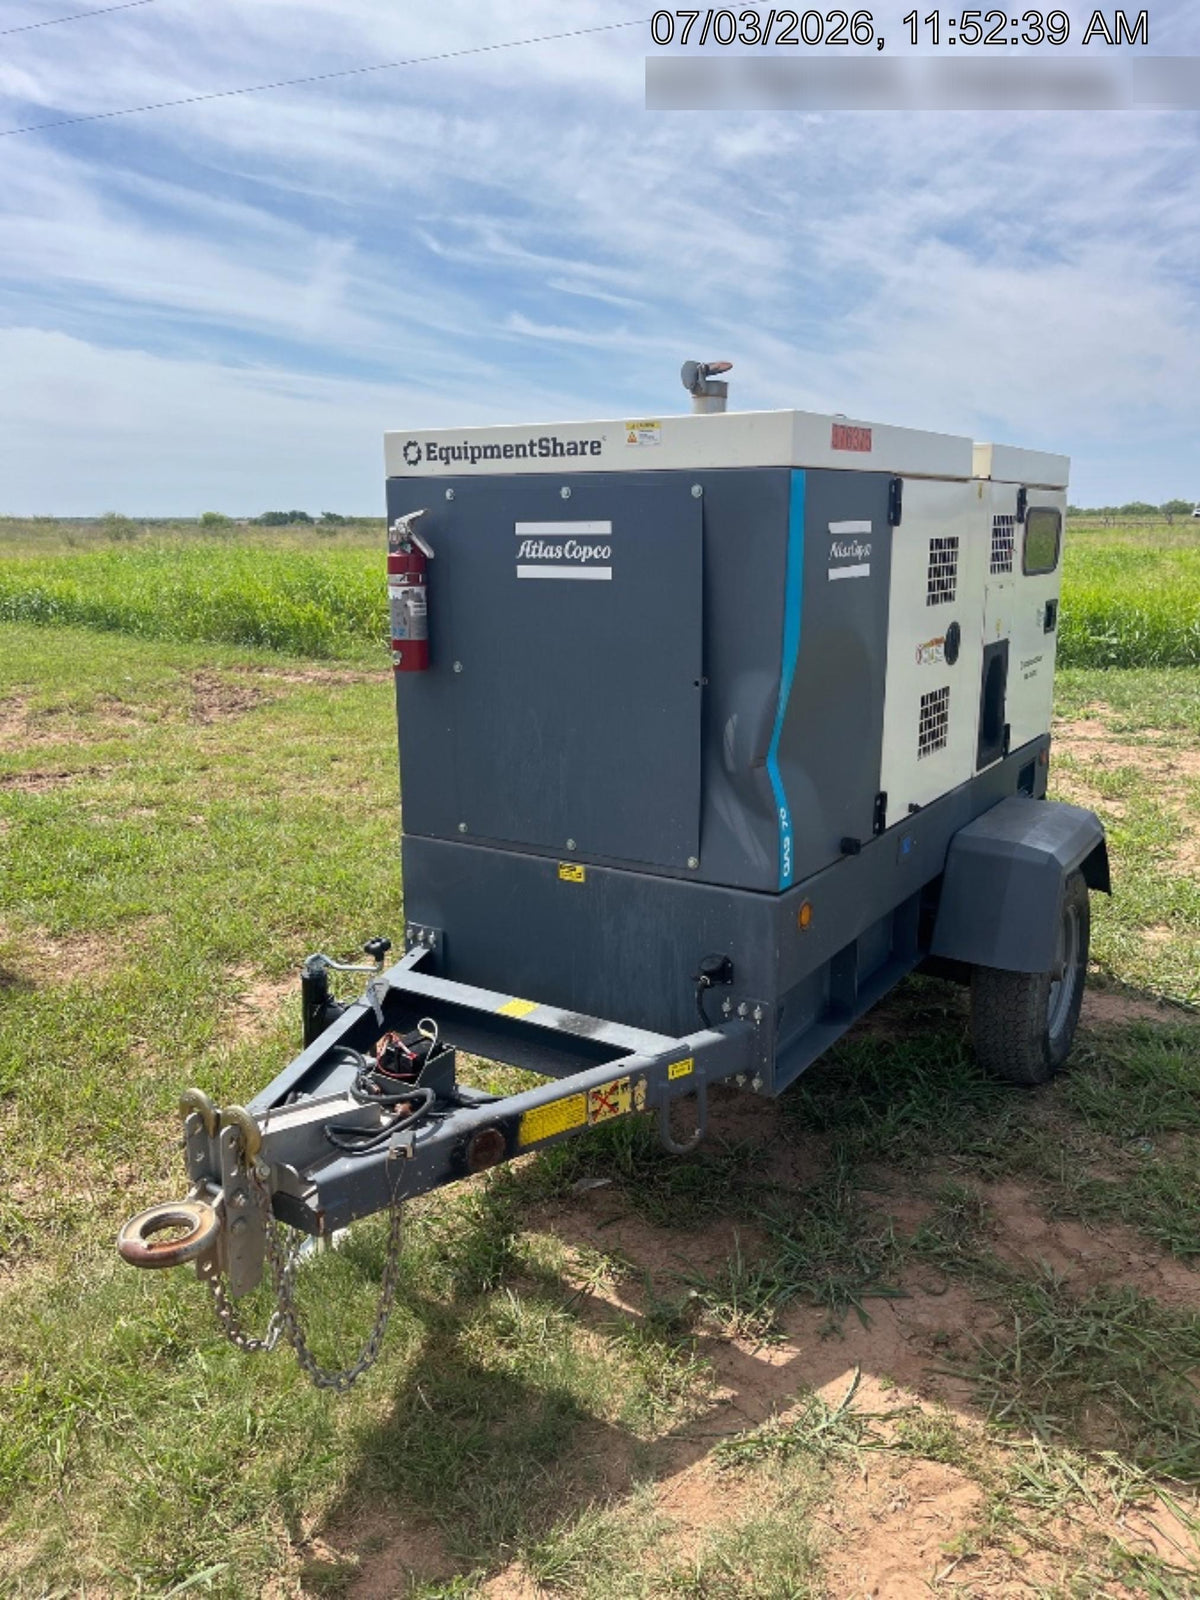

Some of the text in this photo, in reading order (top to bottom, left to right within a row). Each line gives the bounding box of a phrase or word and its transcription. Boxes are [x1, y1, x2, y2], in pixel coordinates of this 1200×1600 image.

[426, 436, 602, 465] EquipmentShare
[516, 539, 611, 562] Atlas Copco
